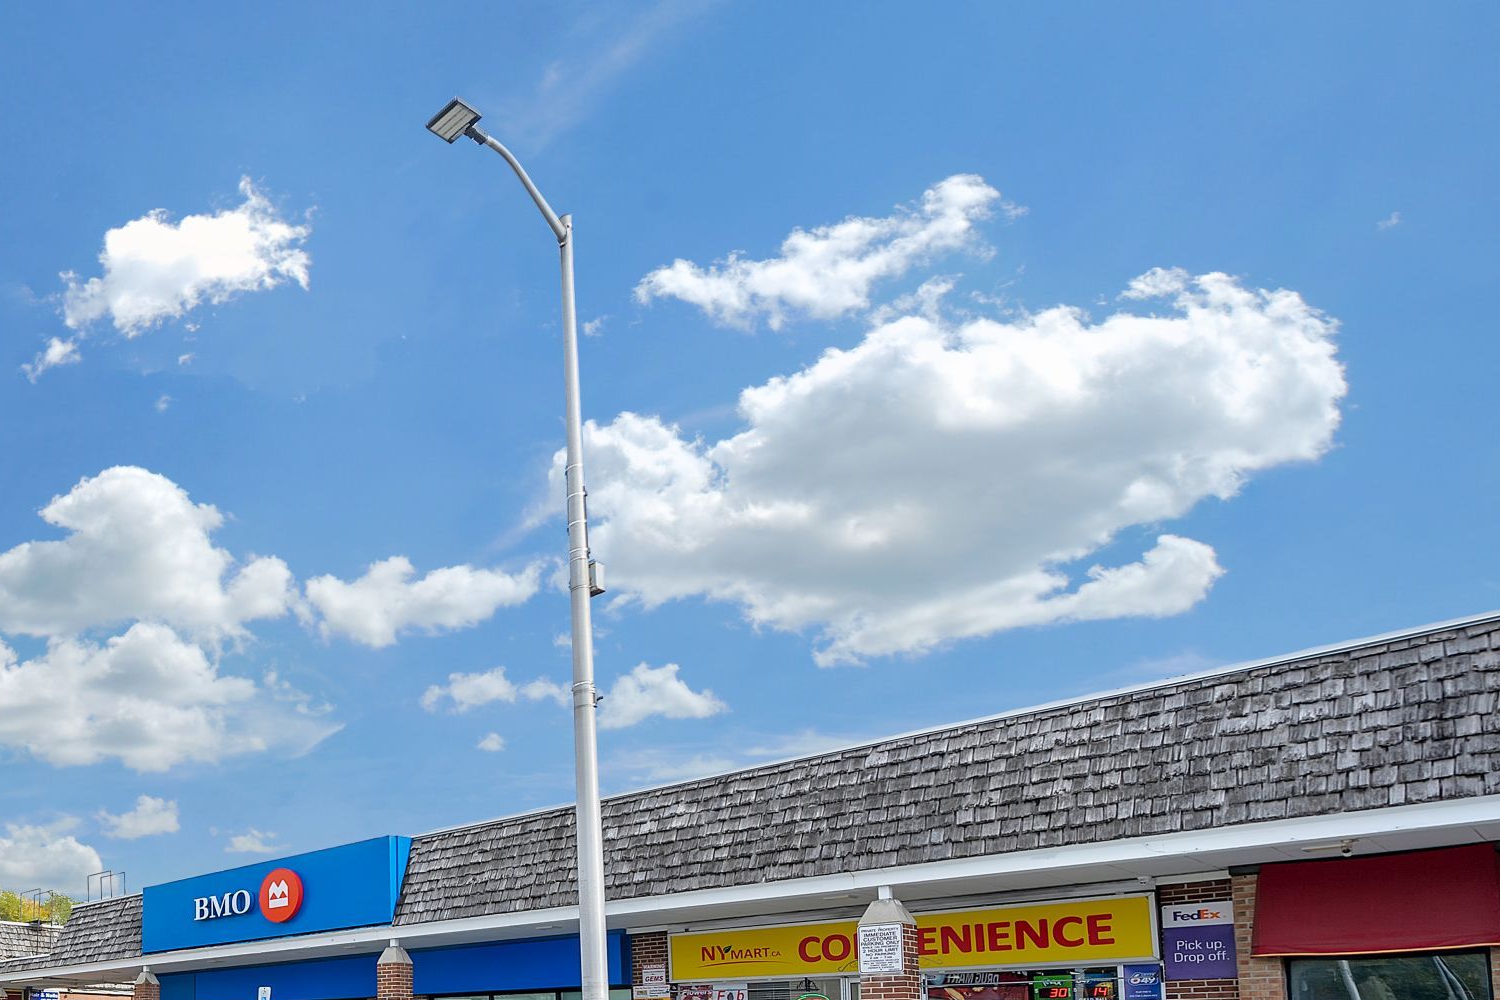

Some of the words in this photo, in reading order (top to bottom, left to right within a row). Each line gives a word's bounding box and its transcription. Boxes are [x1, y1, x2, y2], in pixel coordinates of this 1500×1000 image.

[193, 889, 251, 921] BMO
[1173, 908, 1220, 921] FedEx
[798, 913, 1115, 963] COENIENCE
[1176, 939, 1202, 951] Pick
[1206, 940, 1226, 951] up.
[1174, 952, 1205, 964] Drop
[1208, 950, 1230, 961] off.
[1050, 988, 1068, 998] 30
[1093, 987, 1107, 997] 14
